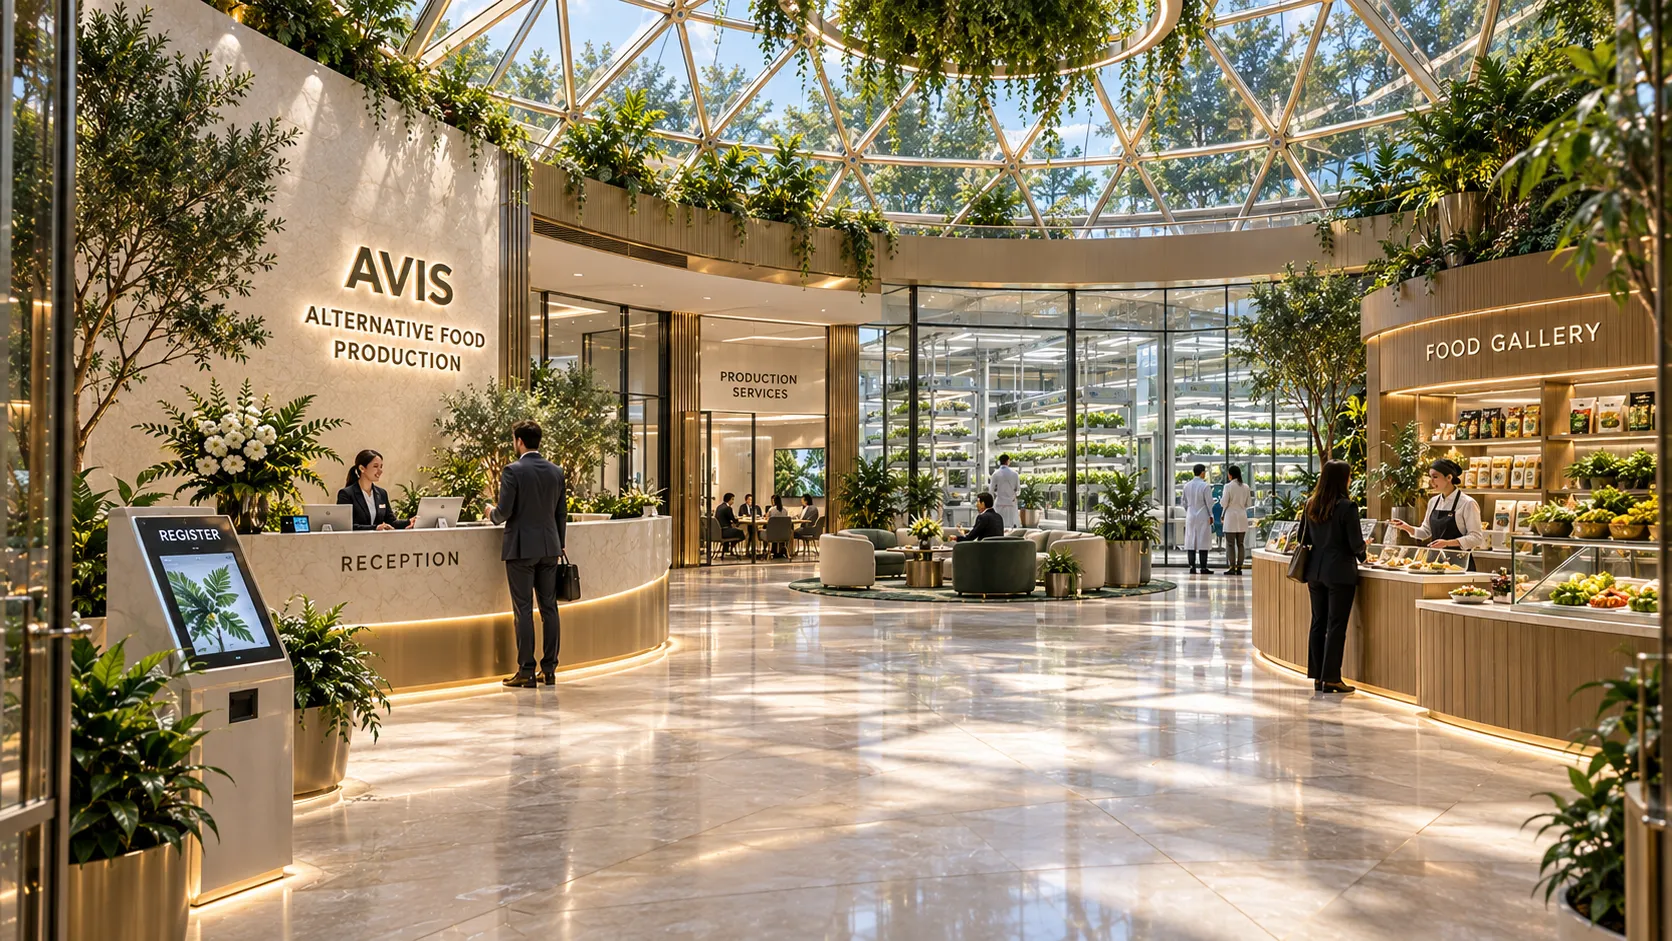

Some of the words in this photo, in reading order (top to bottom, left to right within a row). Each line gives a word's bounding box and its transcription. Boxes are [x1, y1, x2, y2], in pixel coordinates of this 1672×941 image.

[344, 246, 454, 306] AVIS
[305, 305, 434, 341] ALTERNATIVE
[440, 327, 485, 348] FOOD
[1426, 337, 1481, 361] FOOD
[1491, 322, 1602, 352] GALLERY
[334, 340, 461, 372] PRODUCTION
[720, 371, 797, 385] PRODUCTION
[732, 387, 788, 399] SERVICES
[158, 528, 221, 542] REGISTER
[341, 551, 459, 572] RECEPTION
